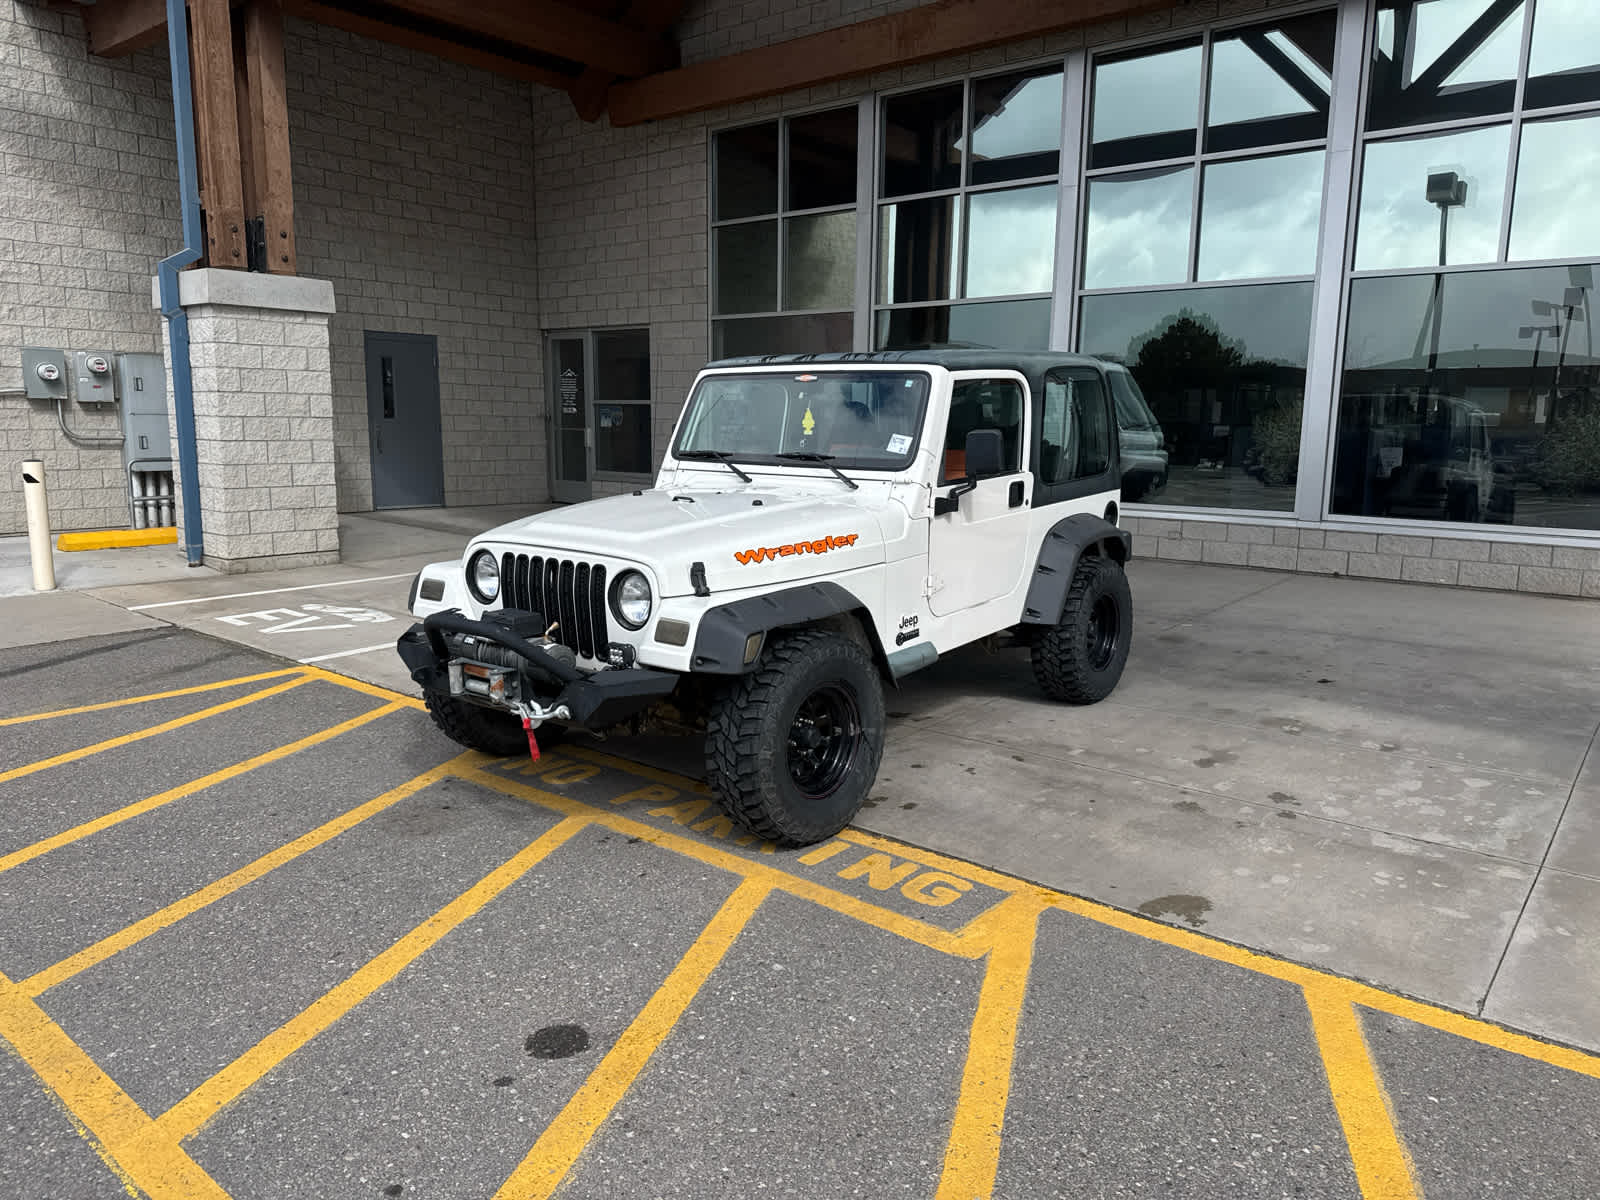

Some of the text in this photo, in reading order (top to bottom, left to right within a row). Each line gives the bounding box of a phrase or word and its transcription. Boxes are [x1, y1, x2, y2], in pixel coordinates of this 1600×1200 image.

[734, 533, 859, 566] Wrangler
[898, 615, 919, 629] Jeep
[502, 757, 601, 785] NO
